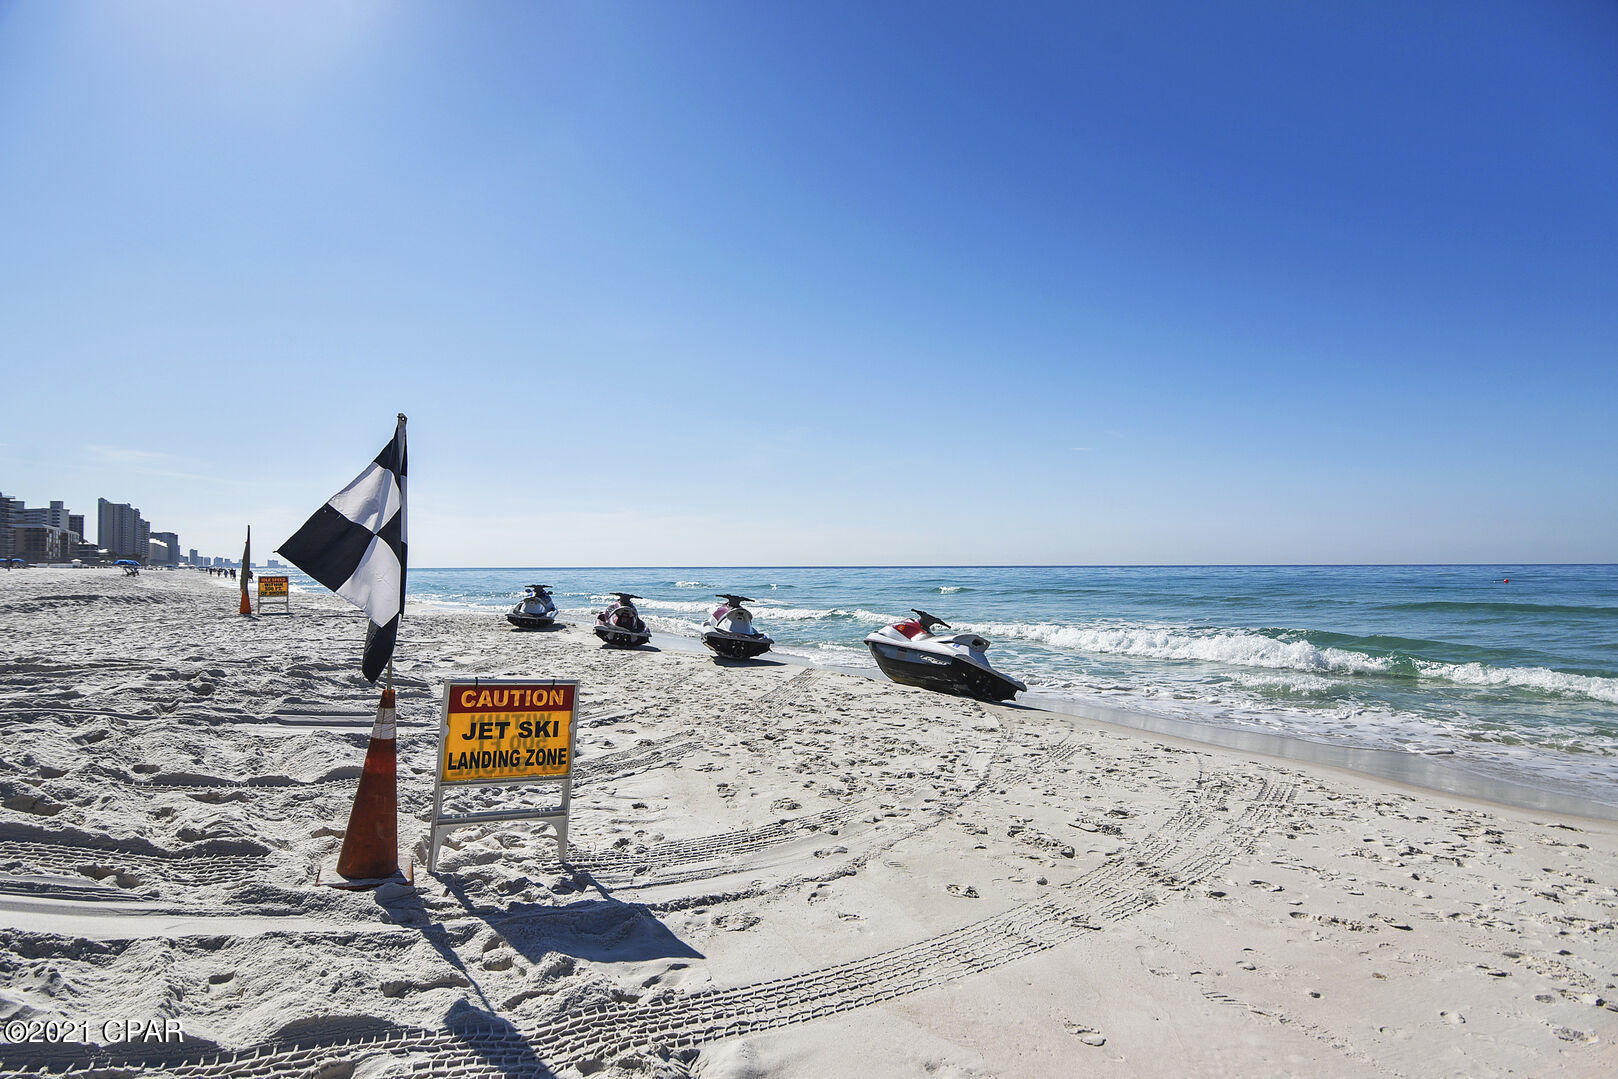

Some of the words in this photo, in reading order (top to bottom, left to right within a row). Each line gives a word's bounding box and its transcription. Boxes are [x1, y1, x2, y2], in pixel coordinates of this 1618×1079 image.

[461, 689, 564, 708] CAUTION
[462, 721, 510, 741] JET
[518, 720, 560, 739] SKI
[447, 749, 521, 771] LANDING
[524, 748, 567, 767] ZONE
